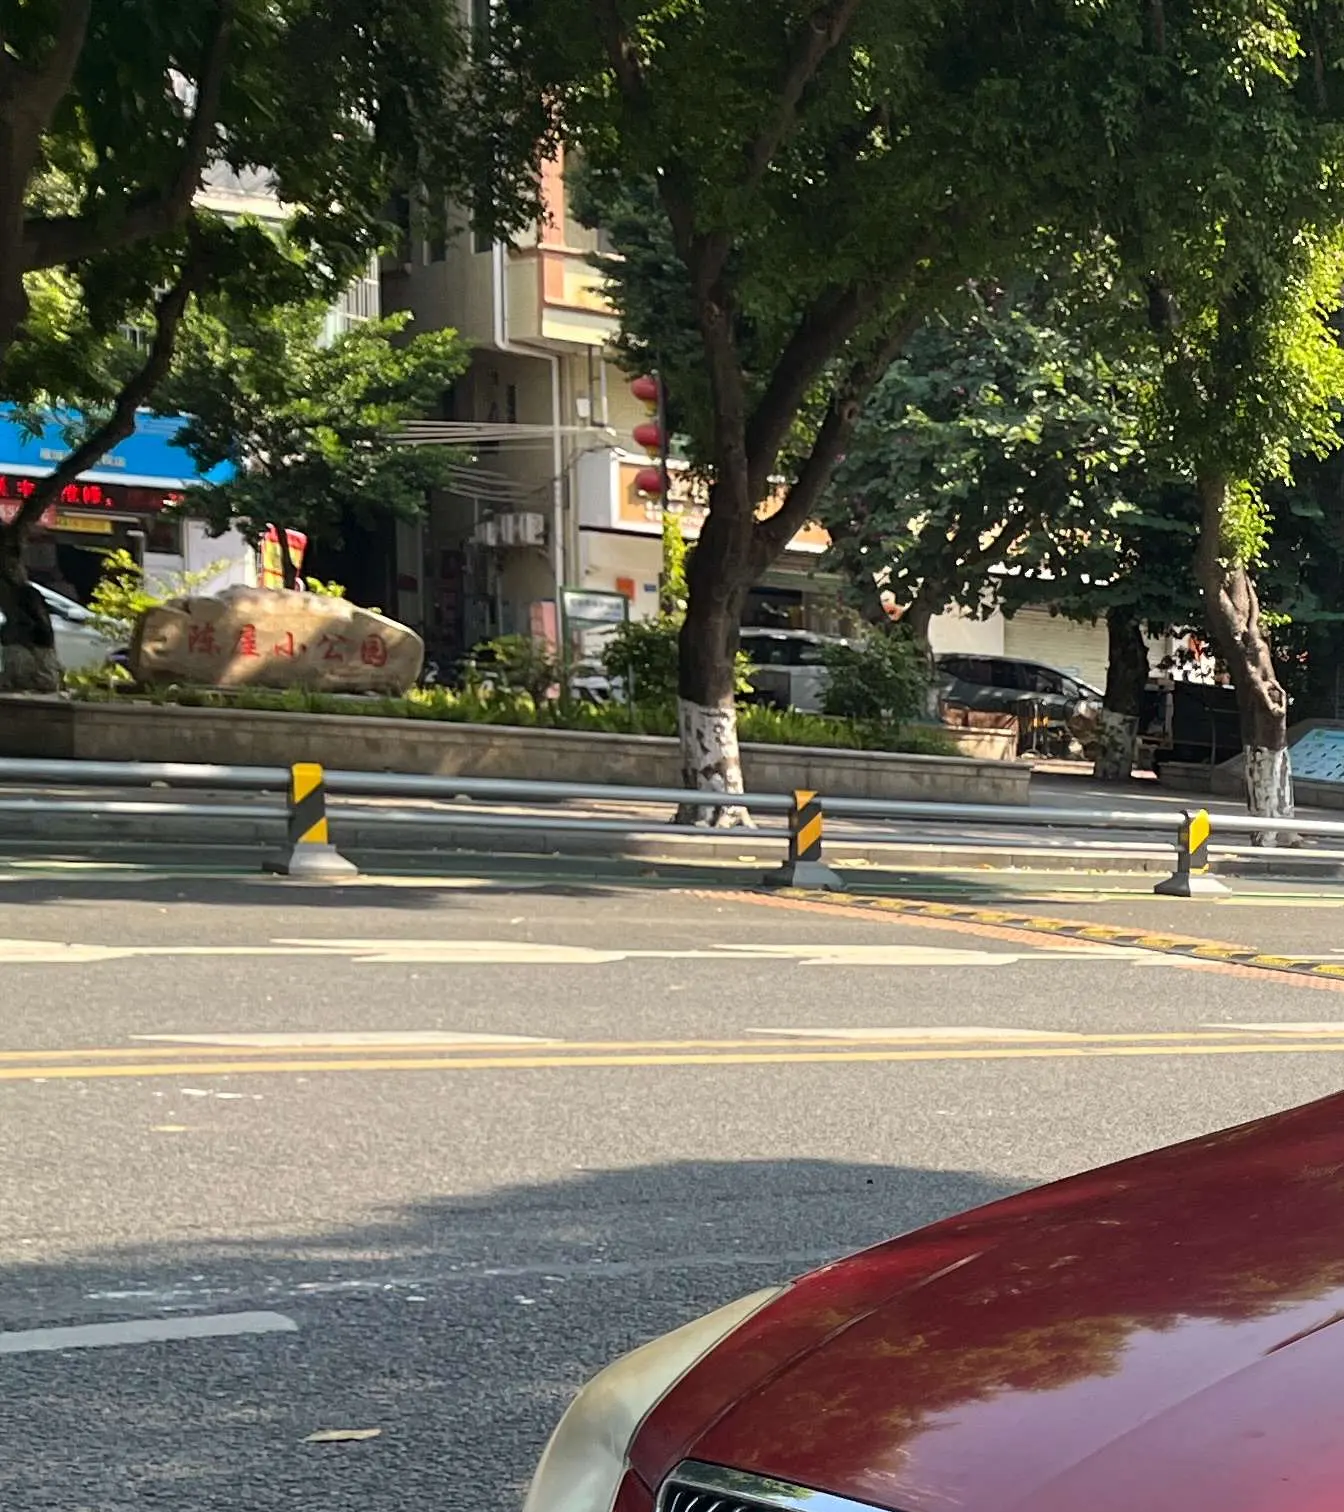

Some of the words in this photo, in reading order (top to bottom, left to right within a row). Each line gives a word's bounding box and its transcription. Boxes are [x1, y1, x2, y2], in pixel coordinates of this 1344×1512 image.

[187, 622, 388, 668] 陈屋小公园
